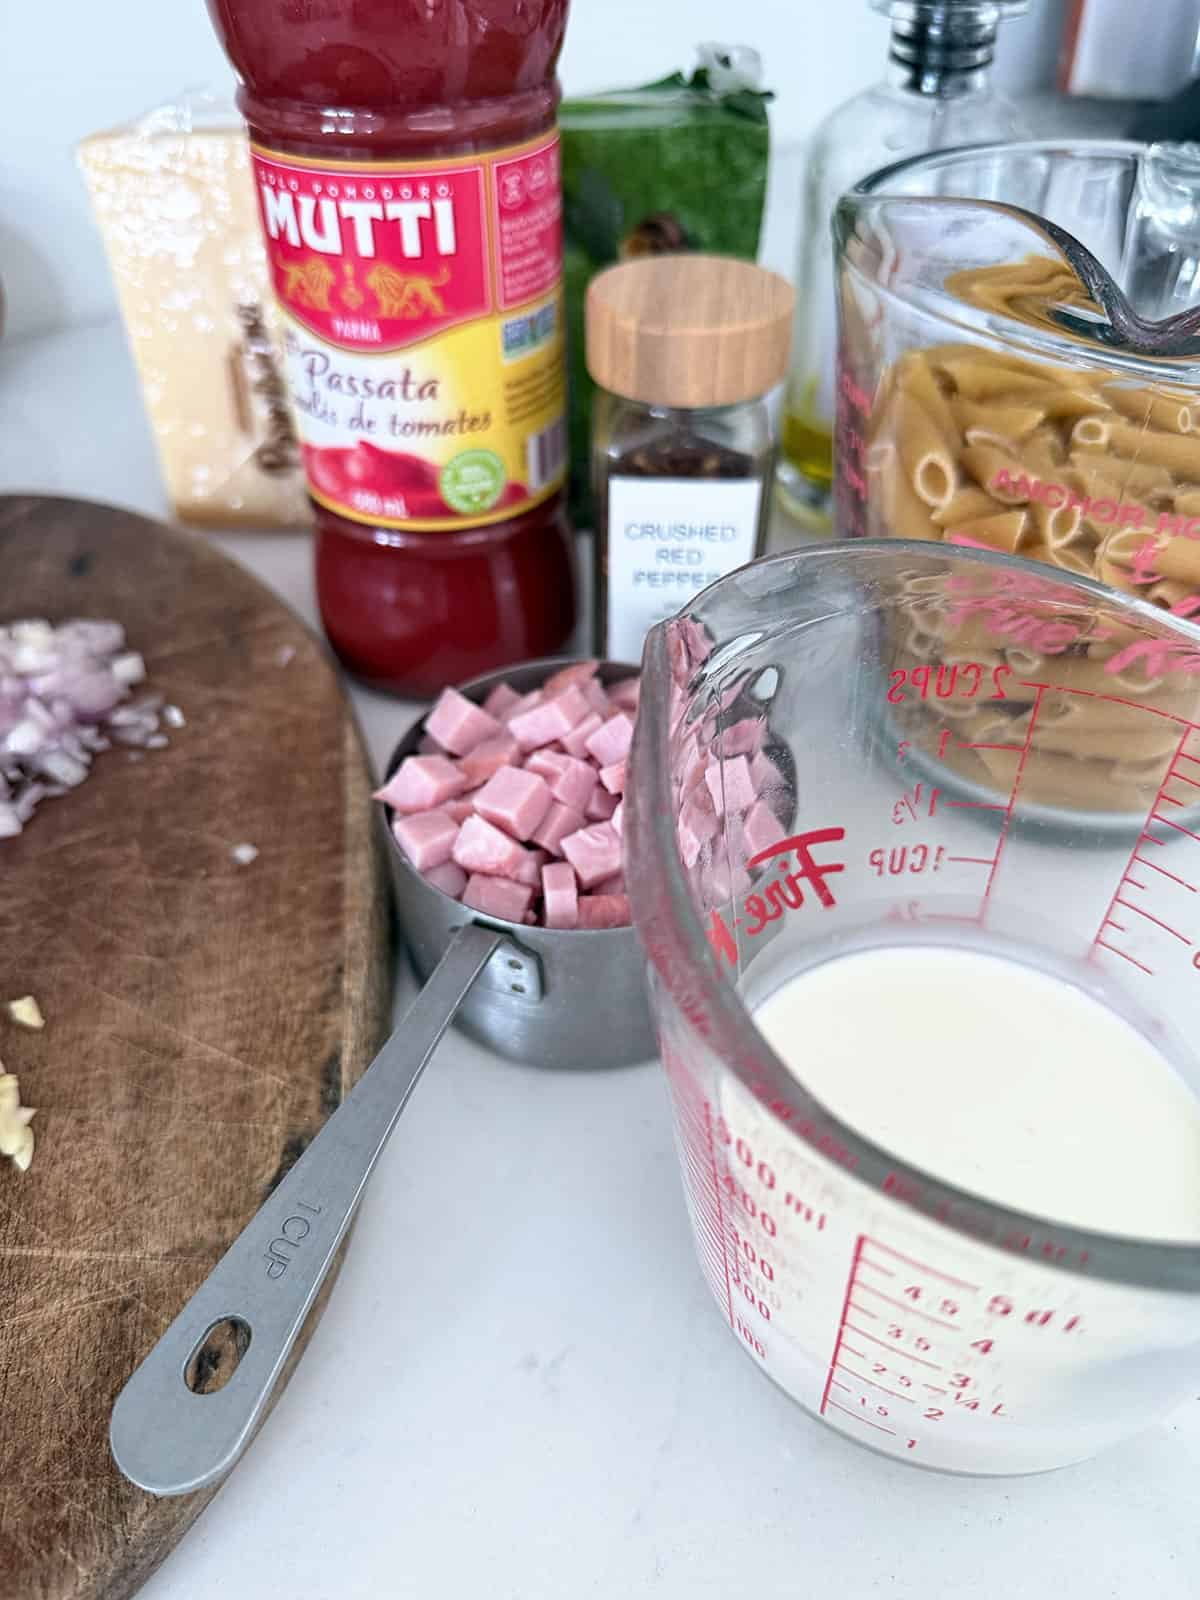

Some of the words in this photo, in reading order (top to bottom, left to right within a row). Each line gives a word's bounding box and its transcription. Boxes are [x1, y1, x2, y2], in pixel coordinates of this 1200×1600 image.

[262, 184, 457, 259] MUTTI
[331, 318, 383, 343] PARMA
[300, 350, 441, 402] Passata
[350, 402, 377, 435] de
[389, 409, 493, 439] tomates
[992, 467, 1147, 529] ANCHOR
[623, 521, 737, 542] CRUSHED
[655, 547, 704, 566] RED
[785, 1192, 827, 1232] ml
[263, 1214, 311, 1280] CUP
[922, 1406, 946, 1422] 2
